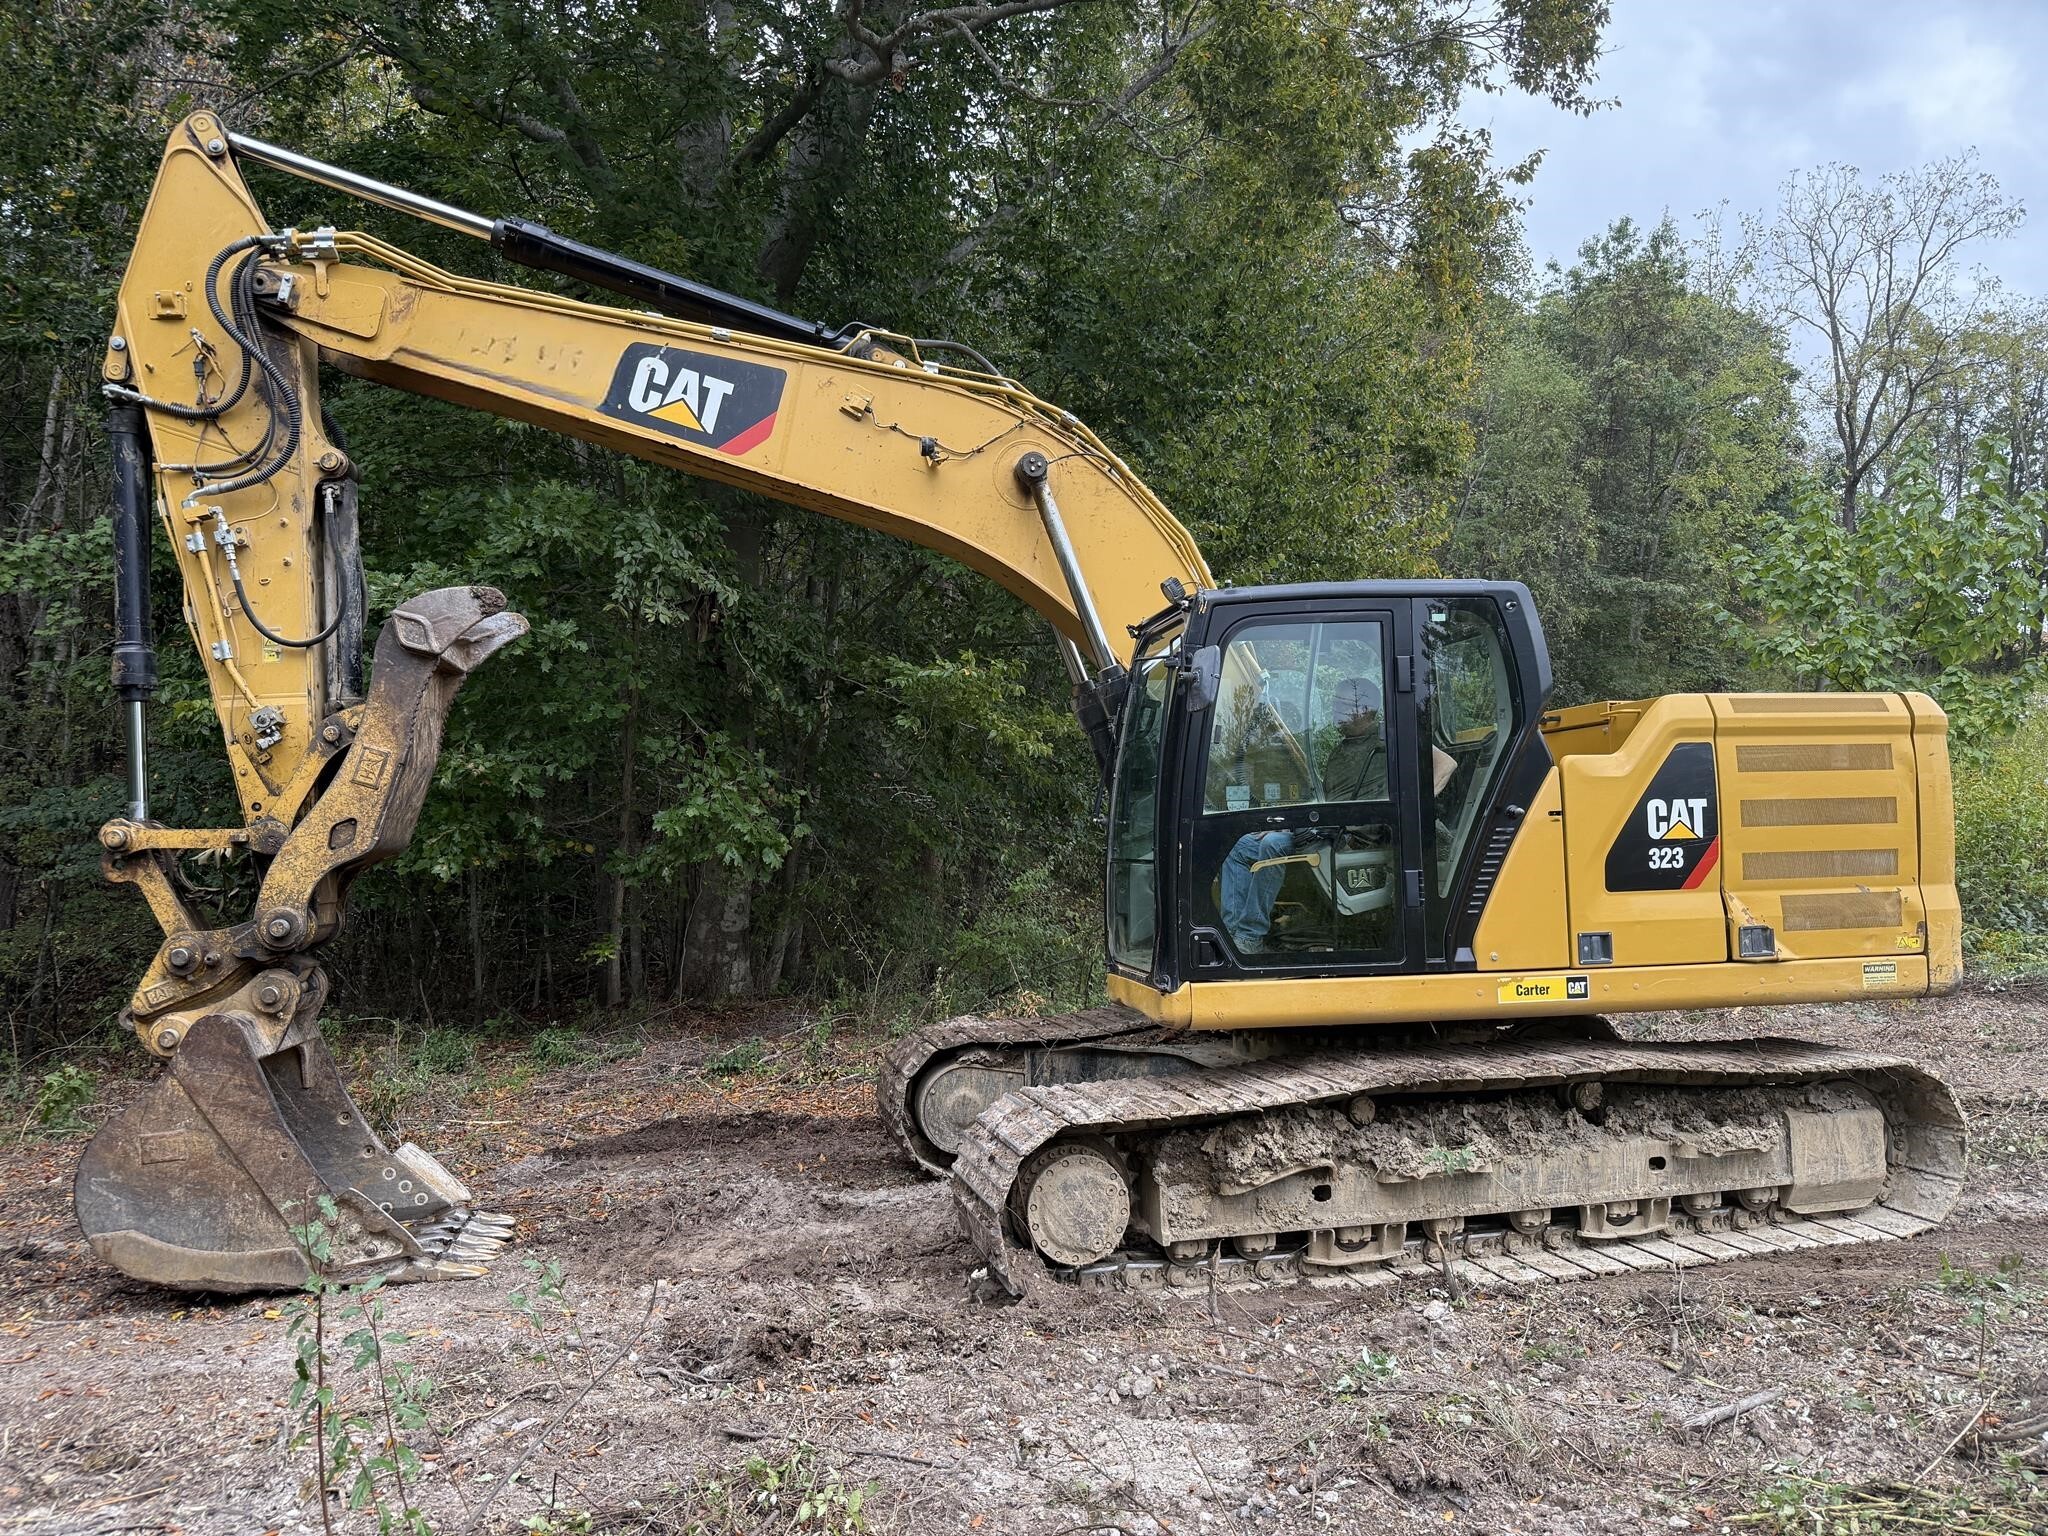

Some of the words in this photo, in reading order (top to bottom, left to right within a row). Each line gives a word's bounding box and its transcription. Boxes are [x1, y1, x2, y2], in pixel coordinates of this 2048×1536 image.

[628, 357, 735, 434] CAT
[1647, 798, 1707, 840] CAT
[1648, 847, 1684, 869] 323
[1347, 868, 1376, 889] CAT
[1864, 965, 1895, 973] WARNING
[1516, 984, 1550, 996] Carter
[1568, 981, 1587, 994] CAT
